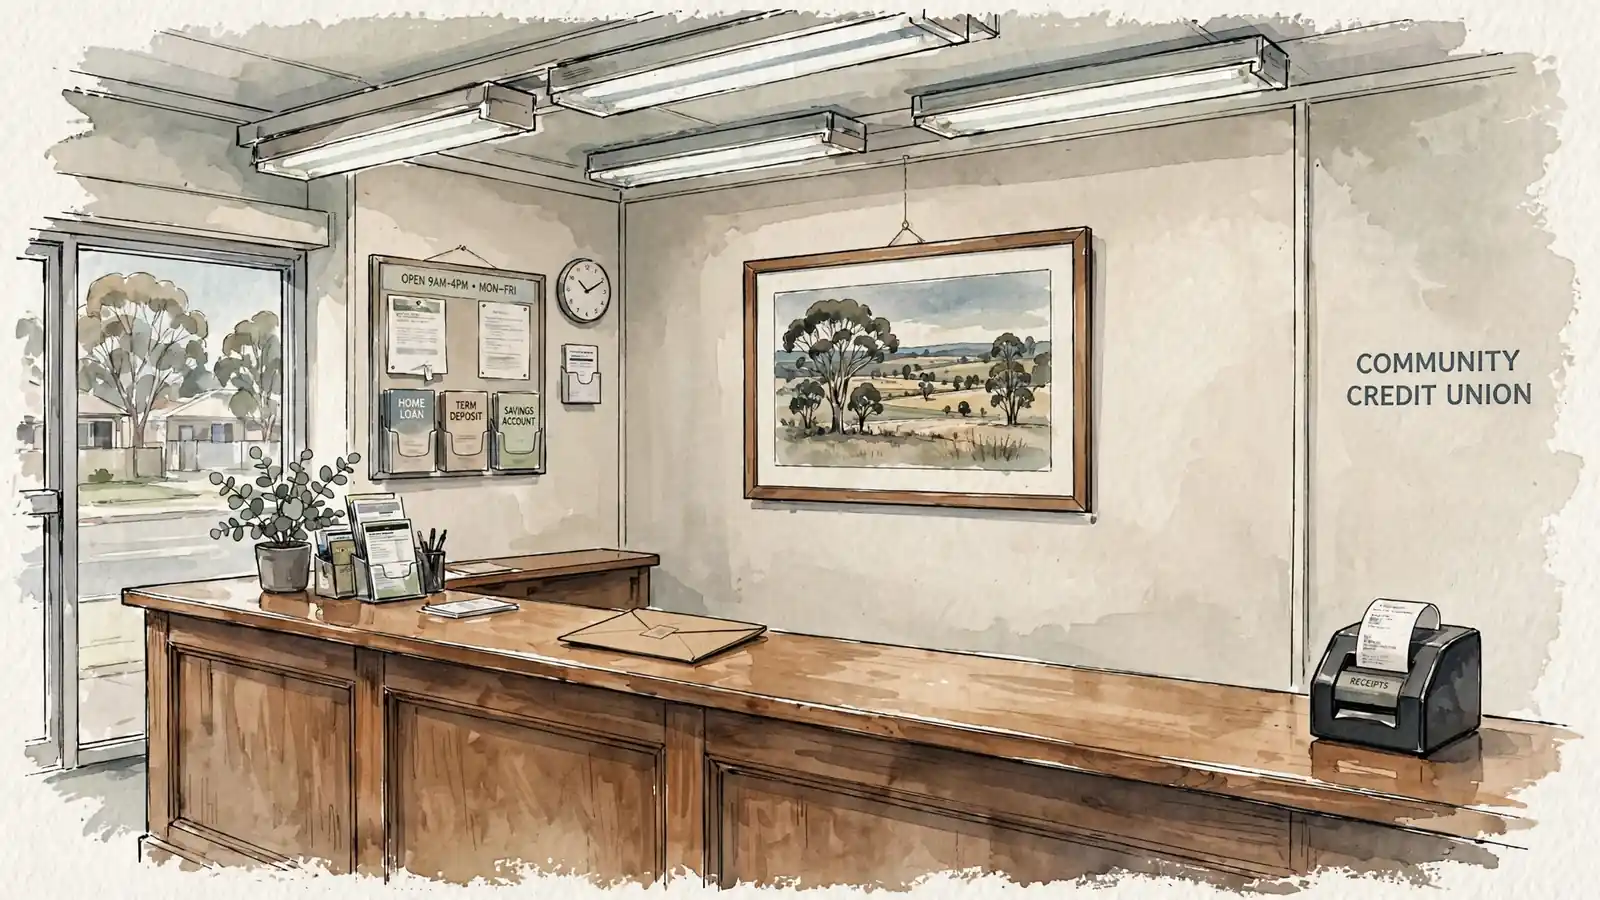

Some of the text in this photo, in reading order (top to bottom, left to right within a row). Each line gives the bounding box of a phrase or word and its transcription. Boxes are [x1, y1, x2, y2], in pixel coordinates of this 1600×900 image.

[401, 273, 426, 286] OPEN
[428, 276, 469, 290] 9AM-4PM
[1356, 349, 1520, 374] COMMUNITY
[1346, 382, 1532, 406] CREDIT UNION
[398, 398, 426, 408] HOME
[456, 400, 476, 410] TERM
[400, 409, 424, 419] LOAN
[450, 411, 482, 421] DEPOSIT
[504, 406, 534, 416] SAVINGS
[502, 416, 536, 426] ACCOUNT
[1350, 677, 1388, 689] RECEIPTS
